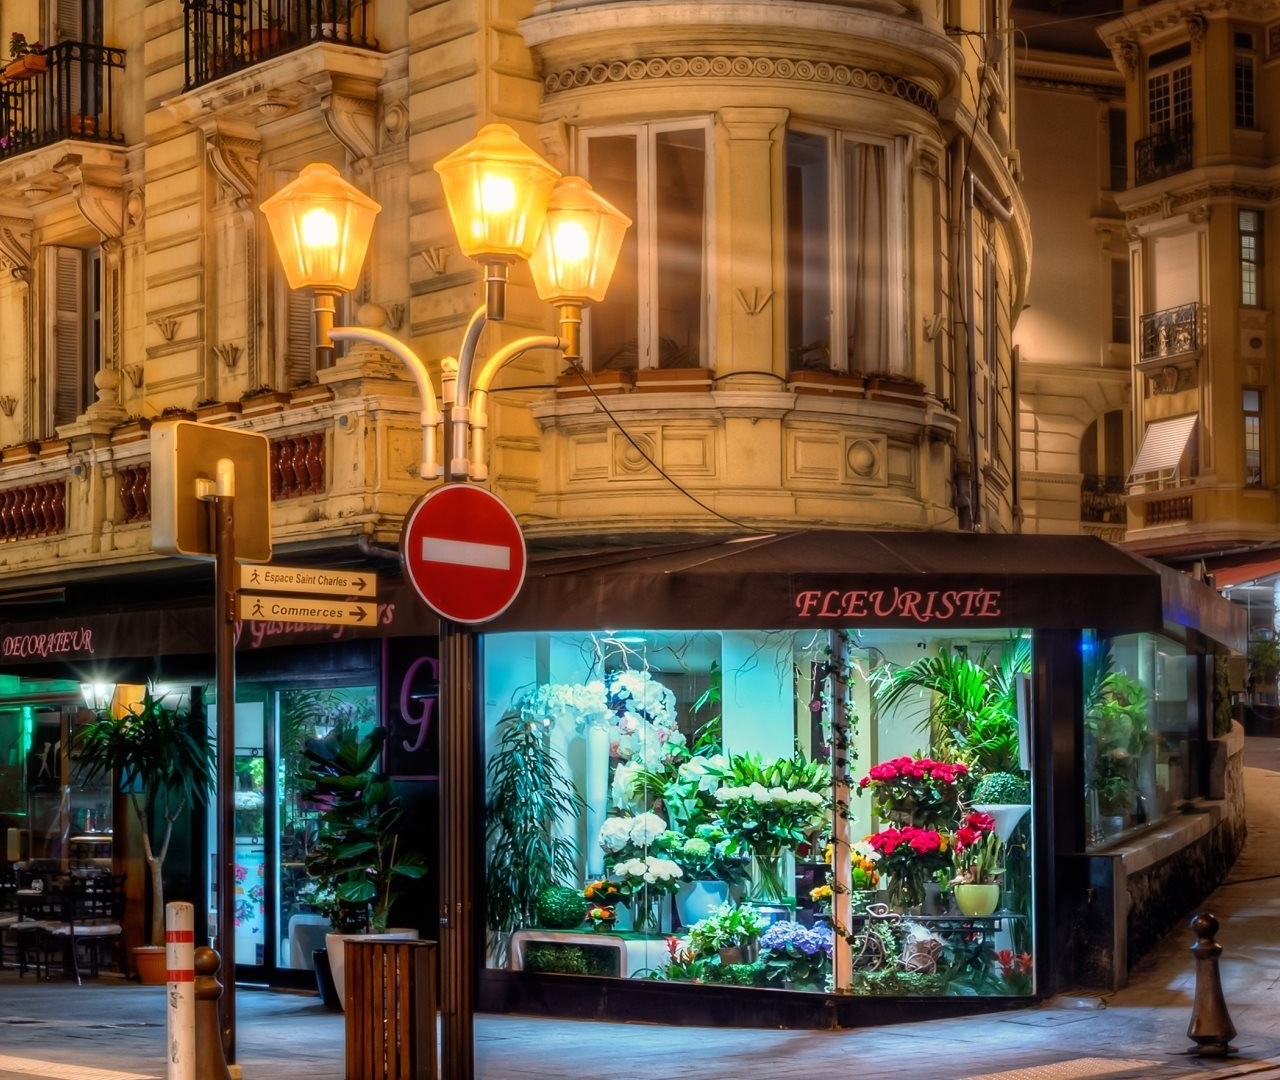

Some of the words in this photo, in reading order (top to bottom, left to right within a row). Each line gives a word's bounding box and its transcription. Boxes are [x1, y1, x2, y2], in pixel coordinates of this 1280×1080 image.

[264, 571, 294, 585] Espace
[296, 573, 316, 585] Saint
[318, 575, 348, 587] Charles
[271, 604, 343, 618] Commerces
[795, 586, 1001, 622] FLEURISTE
[2, 627, 95, 658] DECORATEUR
